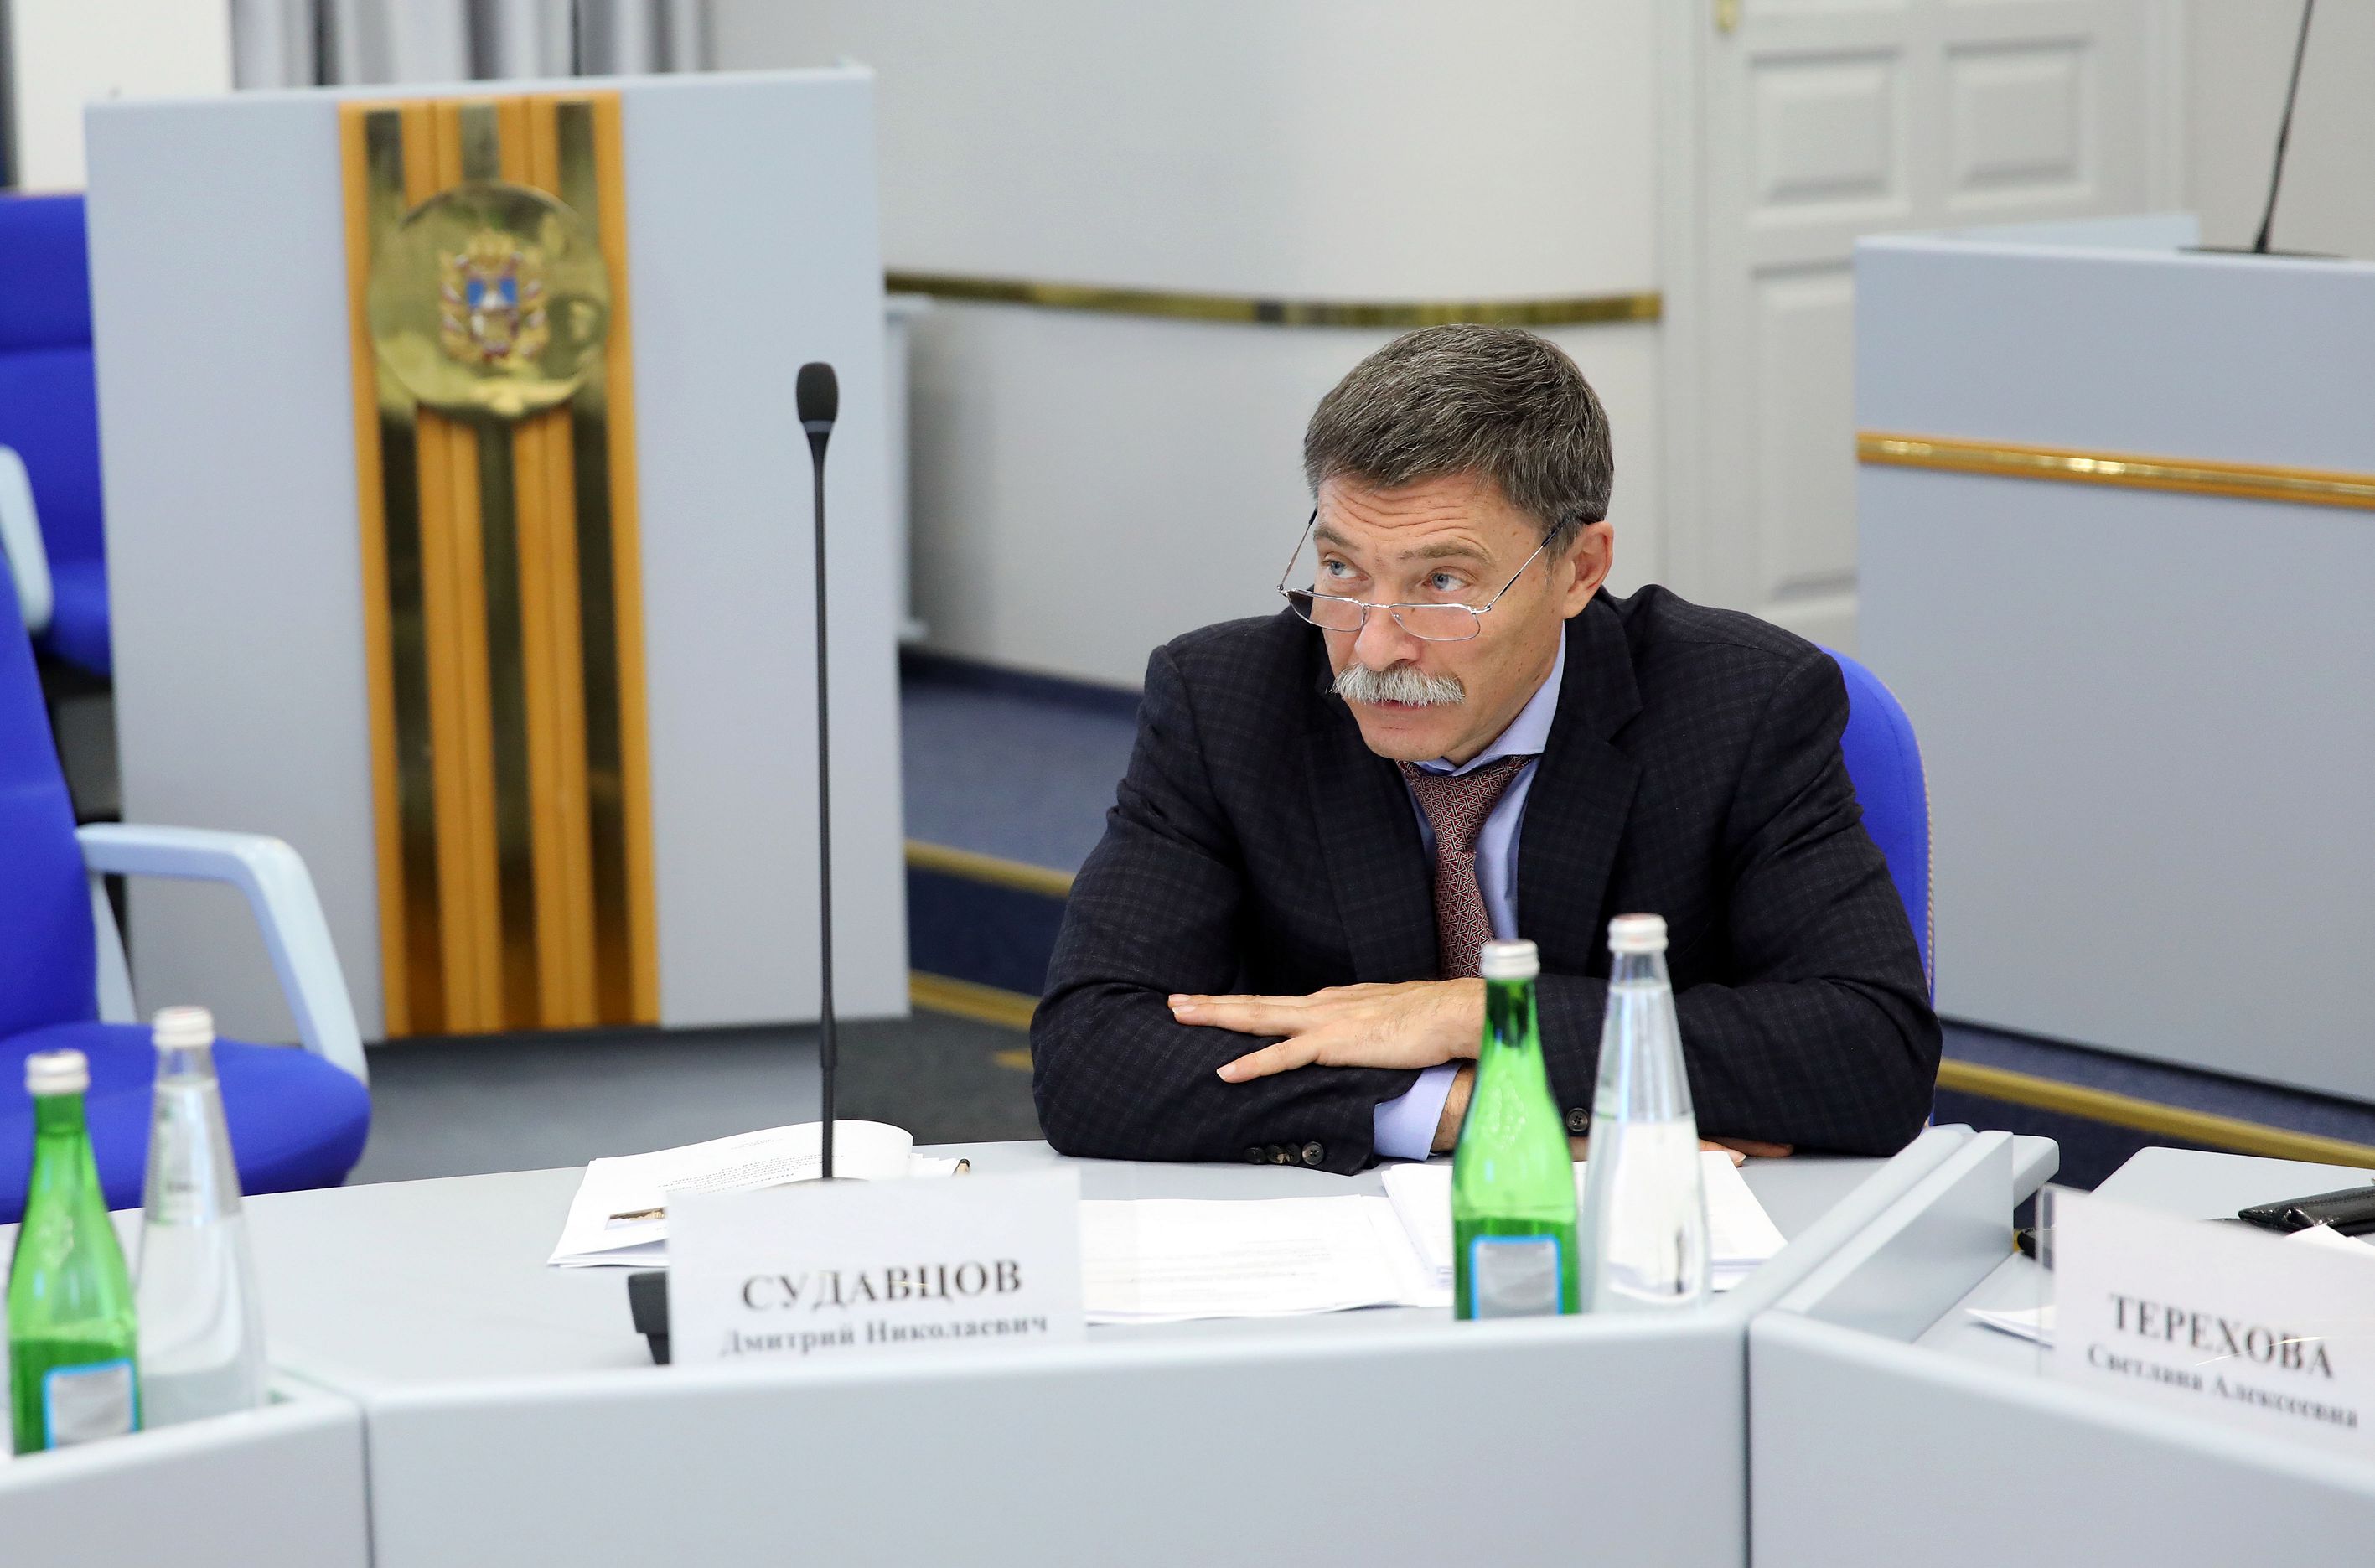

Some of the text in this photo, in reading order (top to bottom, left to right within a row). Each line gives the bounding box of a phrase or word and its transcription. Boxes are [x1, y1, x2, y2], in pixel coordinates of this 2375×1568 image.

[742, 1260, 1023, 1312] СУДАВЦОВ
[721, 1313, 1049, 1356] Дмитрий Николаевич
[2110, 1293, 2336, 1379] ТЕРЕХОВА
[2088, 1343, 2357, 1429] Светлана Алексеевна
